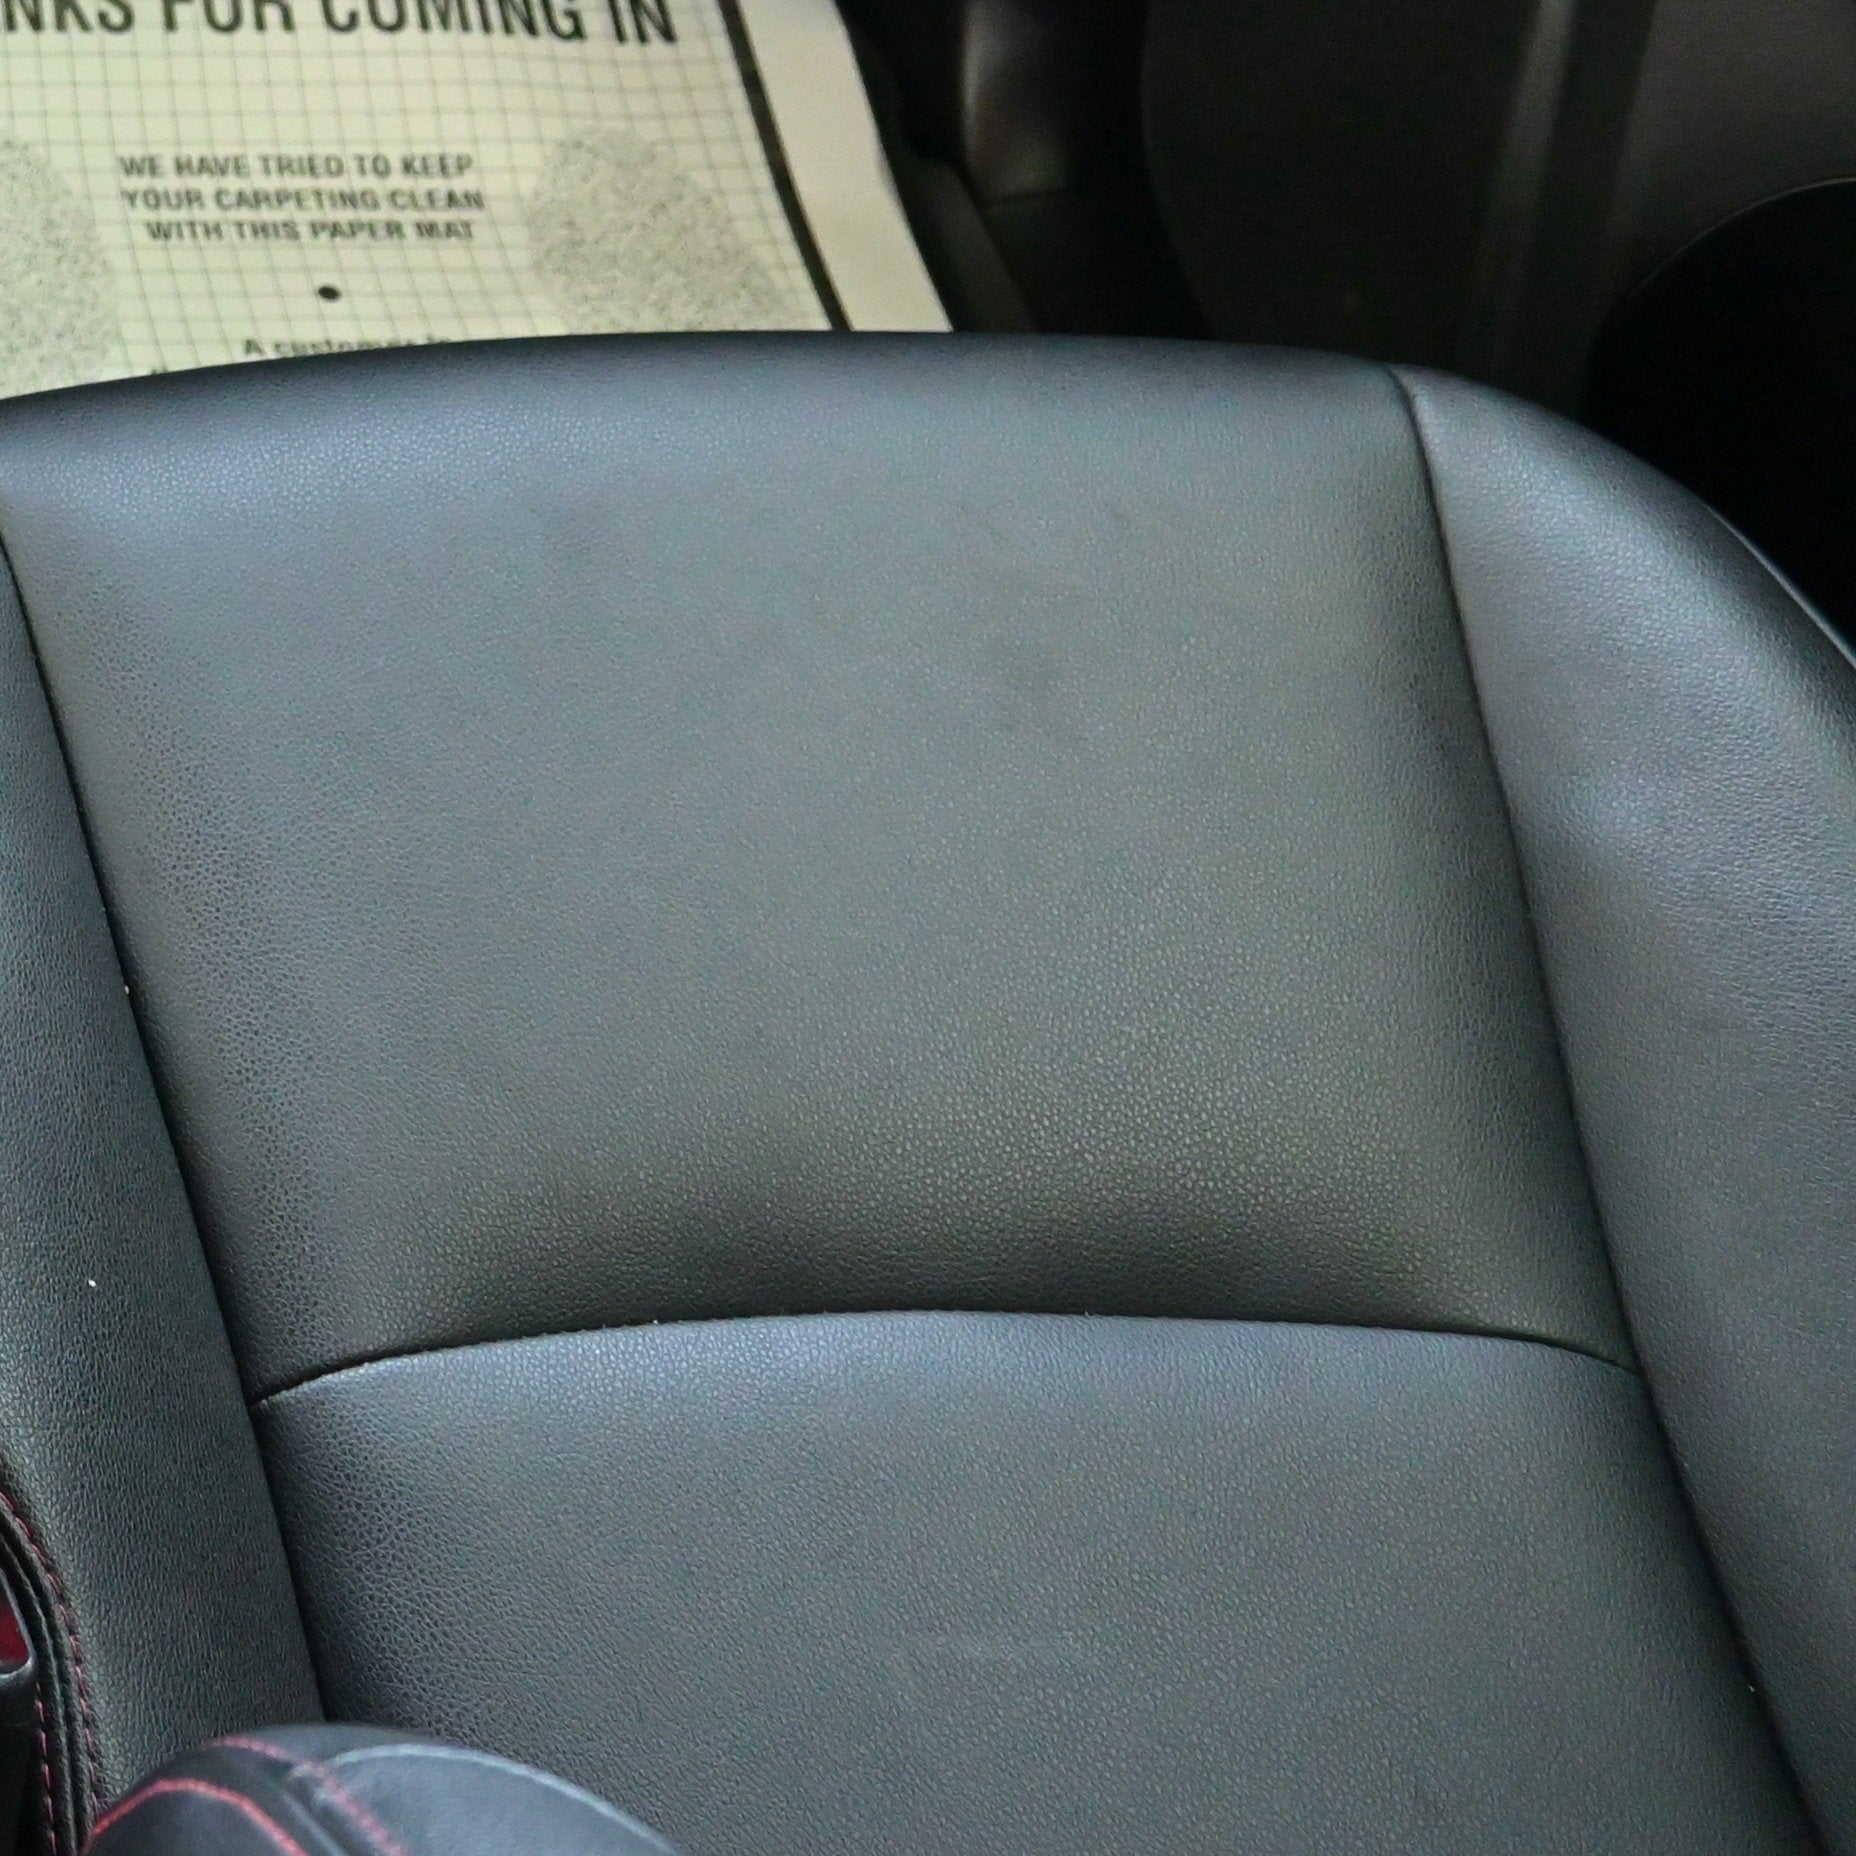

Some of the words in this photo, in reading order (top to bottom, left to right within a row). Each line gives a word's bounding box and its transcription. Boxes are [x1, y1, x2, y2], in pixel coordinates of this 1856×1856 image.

[119, 154, 162, 178] WE
[174, 154, 250, 178] HAVE
[258, 154, 344, 178] TRIED
[354, 154, 392, 178] TO
[402, 154, 474, 178] KEEP
[120, 188, 205, 211] YOUR
[214, 188, 381, 211] CARPETING
[390, 188, 485, 211] CLEAN
[146, 220, 224, 242] WITH
[233, 220, 301, 242] THIS
[311, 220, 405, 241] PAPER
[416, 220, 475, 241] MAT
